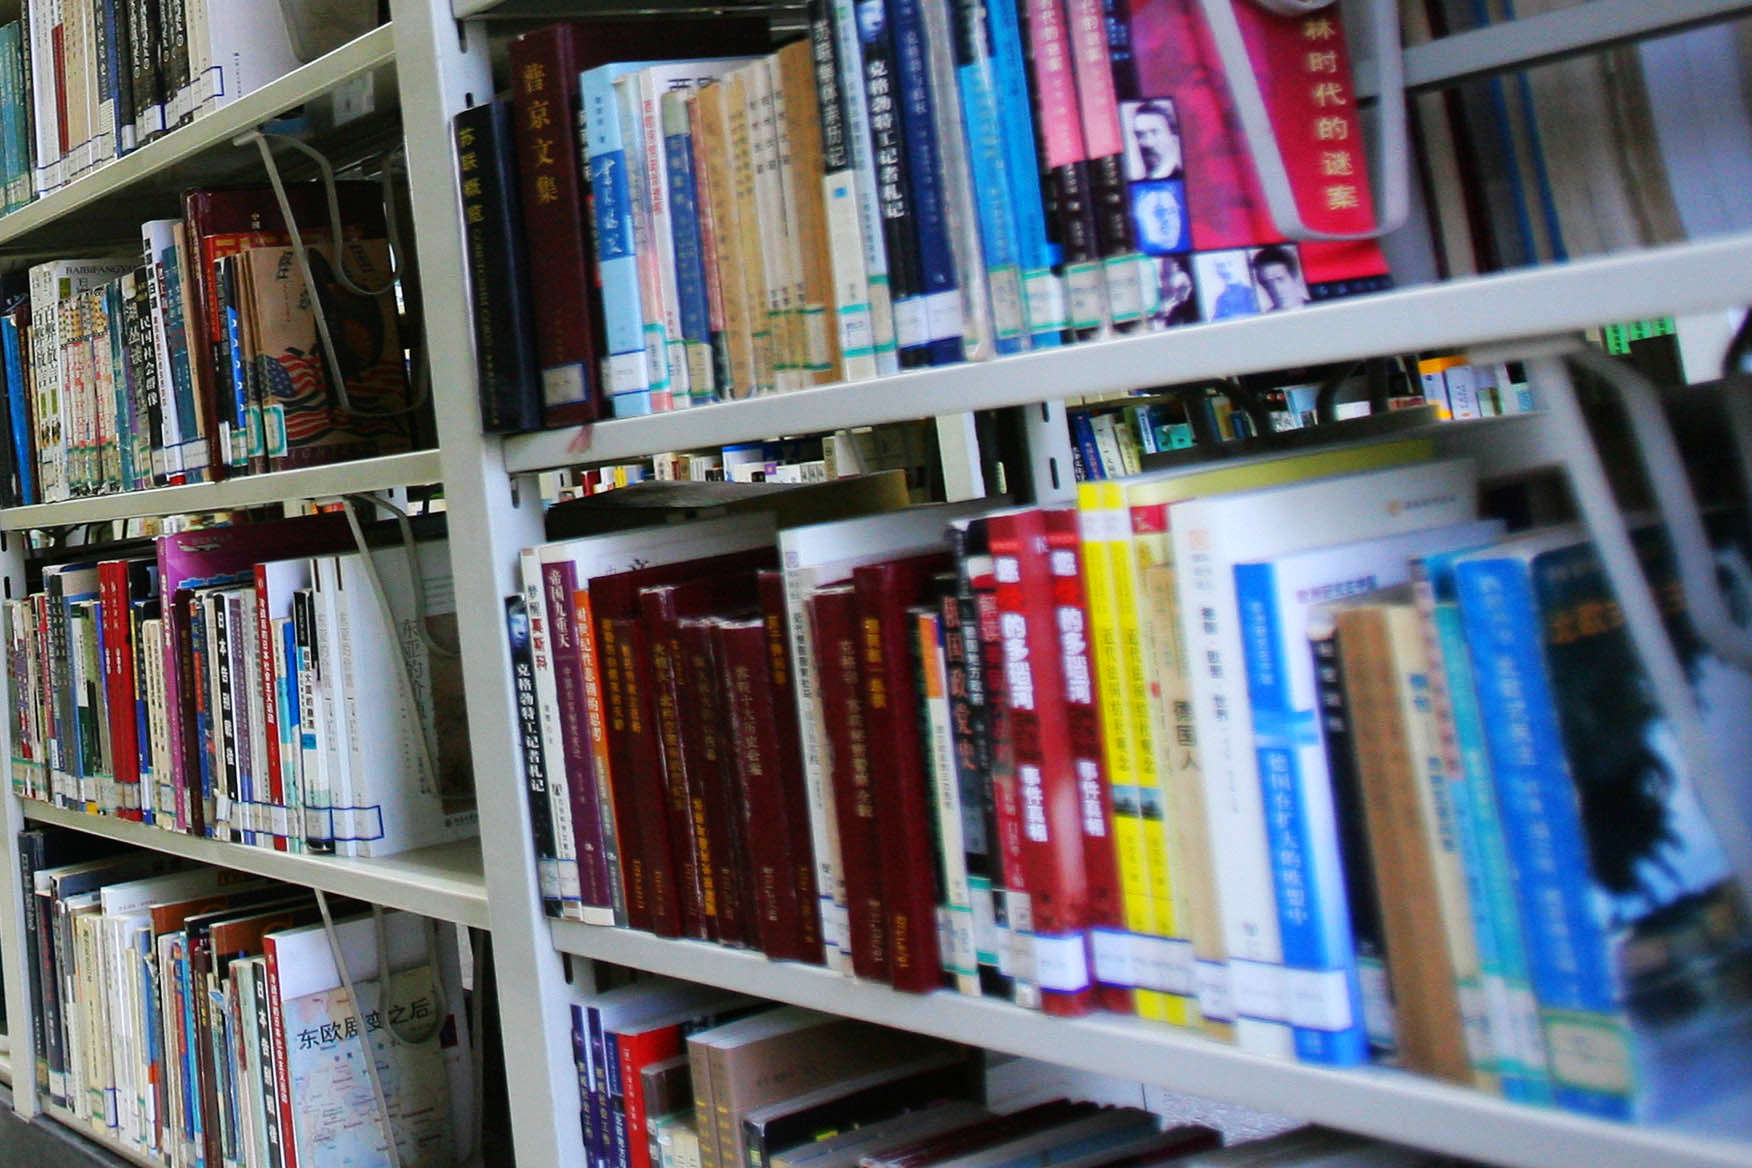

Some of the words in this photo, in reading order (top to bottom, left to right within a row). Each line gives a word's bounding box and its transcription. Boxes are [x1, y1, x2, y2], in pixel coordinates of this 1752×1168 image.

[523, 63, 559, 206] 普京文集
[549, 568, 570, 649] 帝国九重天
